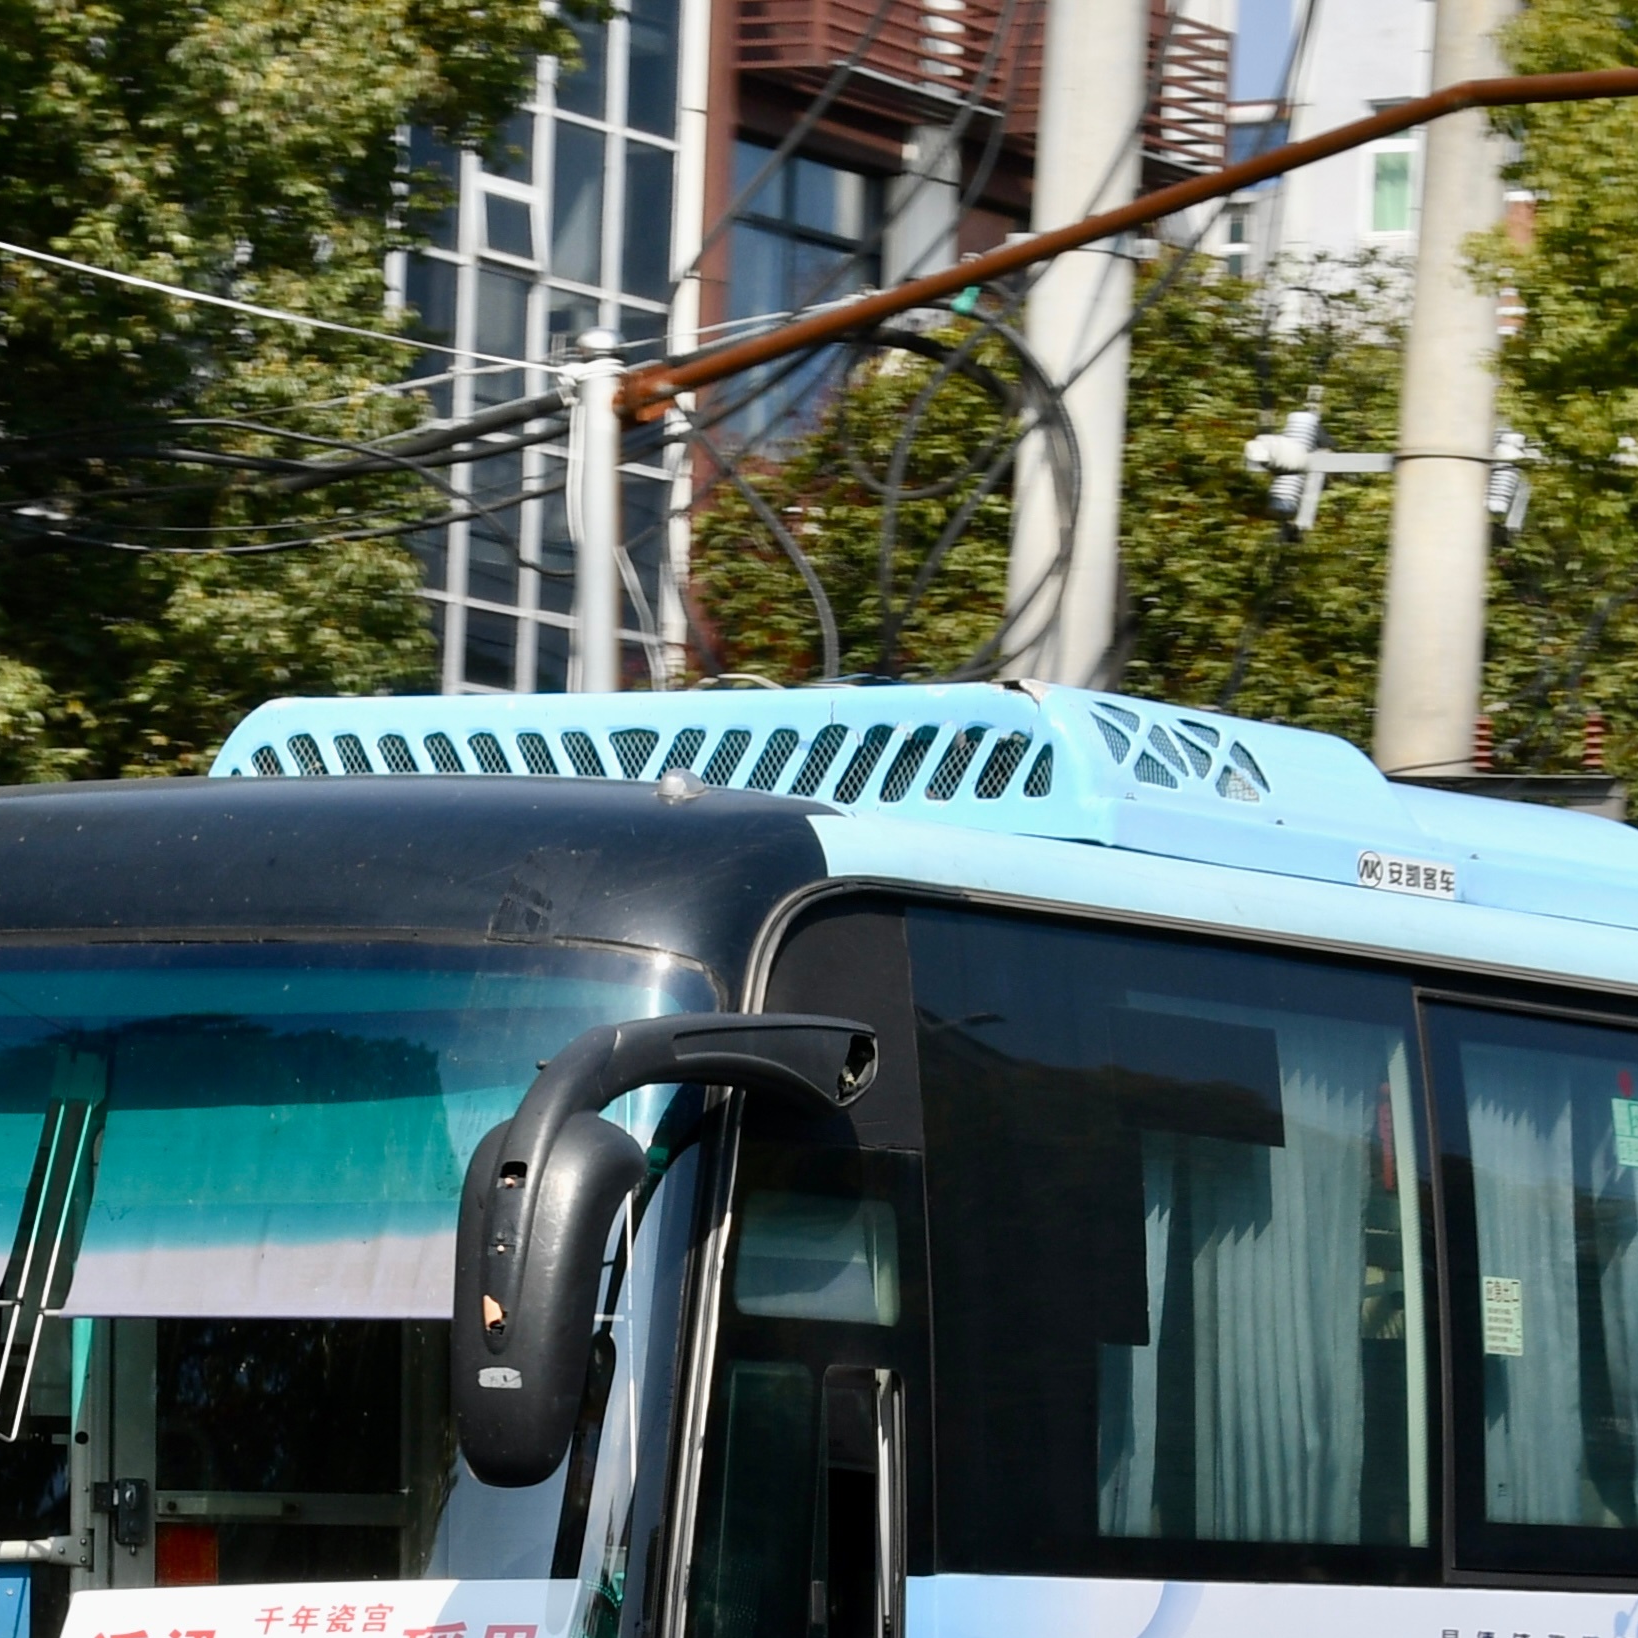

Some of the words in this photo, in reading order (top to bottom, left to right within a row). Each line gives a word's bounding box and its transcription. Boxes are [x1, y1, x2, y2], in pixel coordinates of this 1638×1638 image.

[1388, 861, 1456, 893] 安凯客车
[254, 1603, 395, 1636] 千年瓷宫
